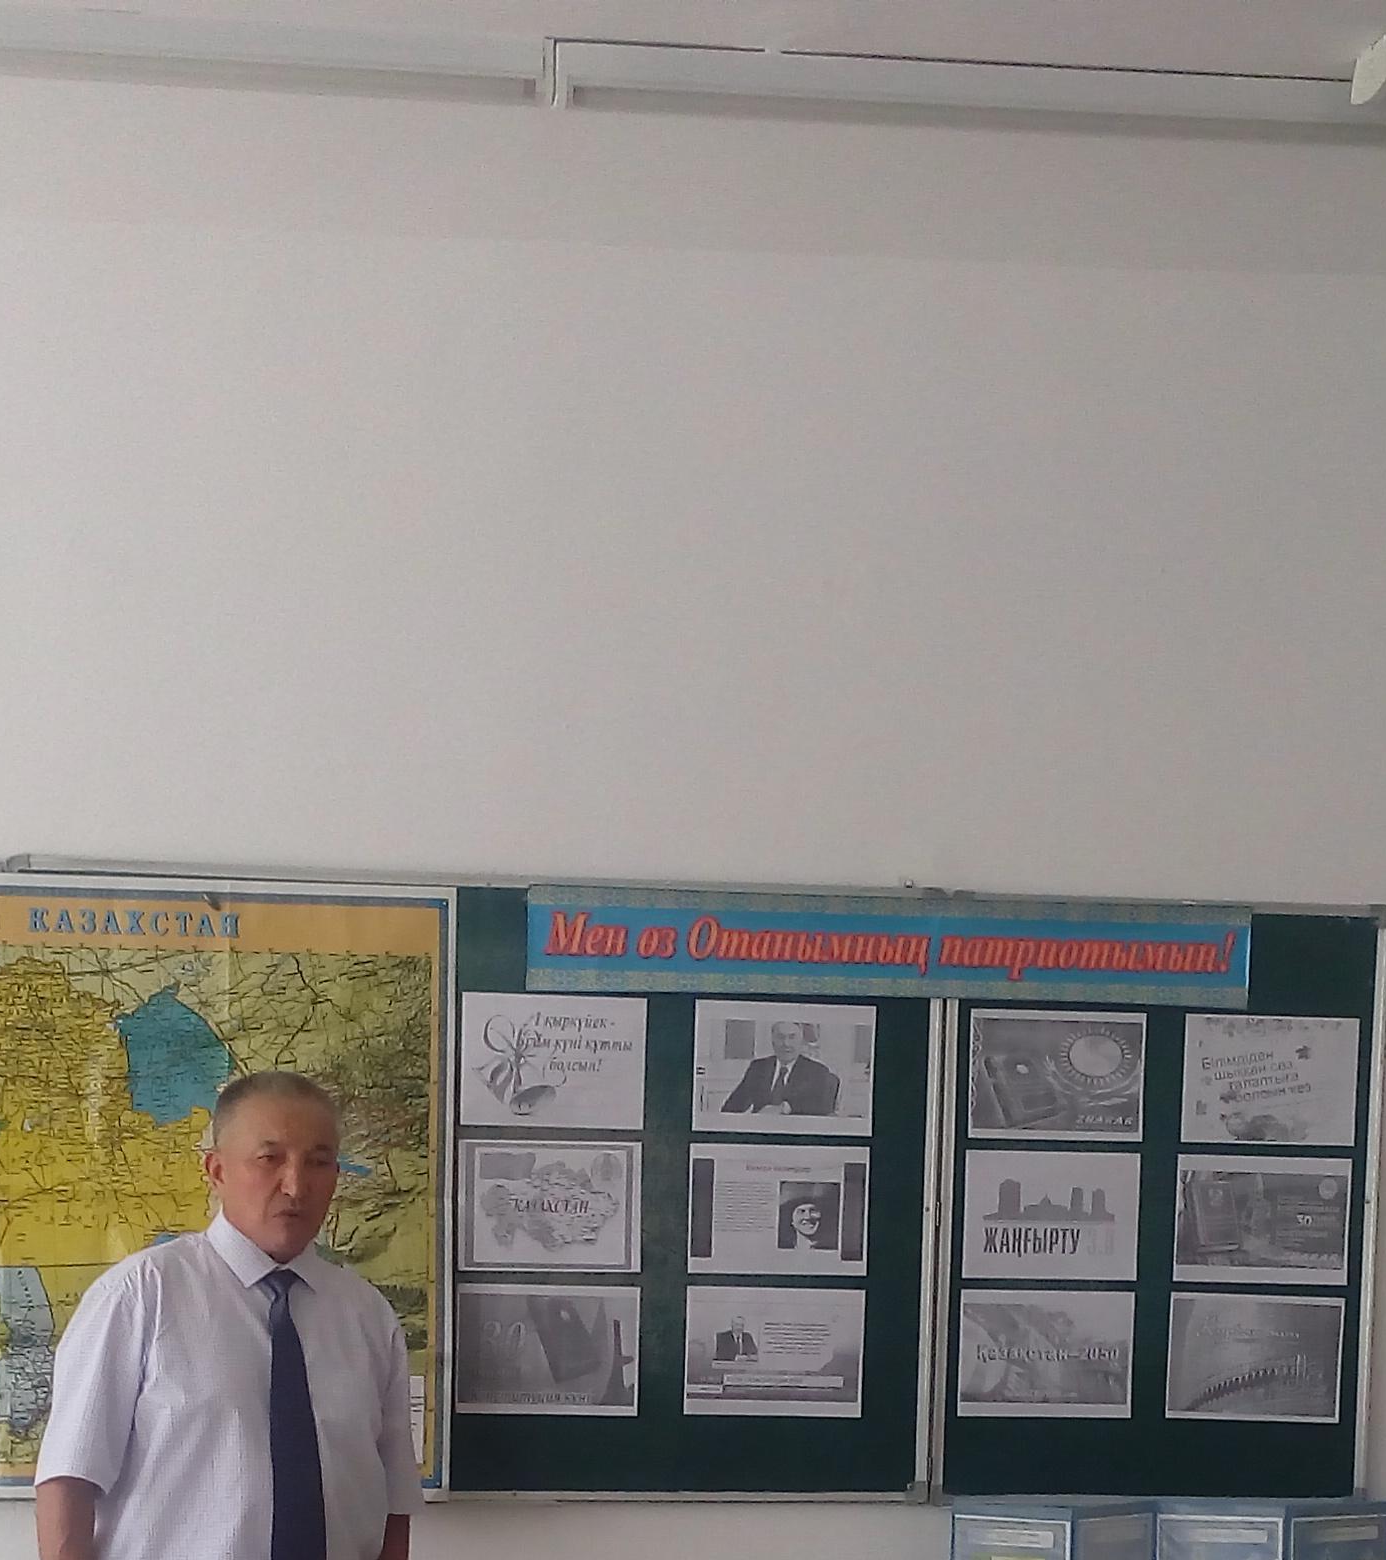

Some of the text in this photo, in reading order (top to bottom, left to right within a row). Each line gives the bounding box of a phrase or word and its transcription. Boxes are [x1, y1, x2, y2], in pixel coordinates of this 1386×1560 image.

[26, 907, 241, 939] КАЗАХСТАН
[545, 911, 629, 958] Мен
[686, 915, 931, 977] Отанымның
[939, 932, 1237, 981] патриотымын!
[983, 1227, 1081, 1258] ЖАҢҒЫРТУ
